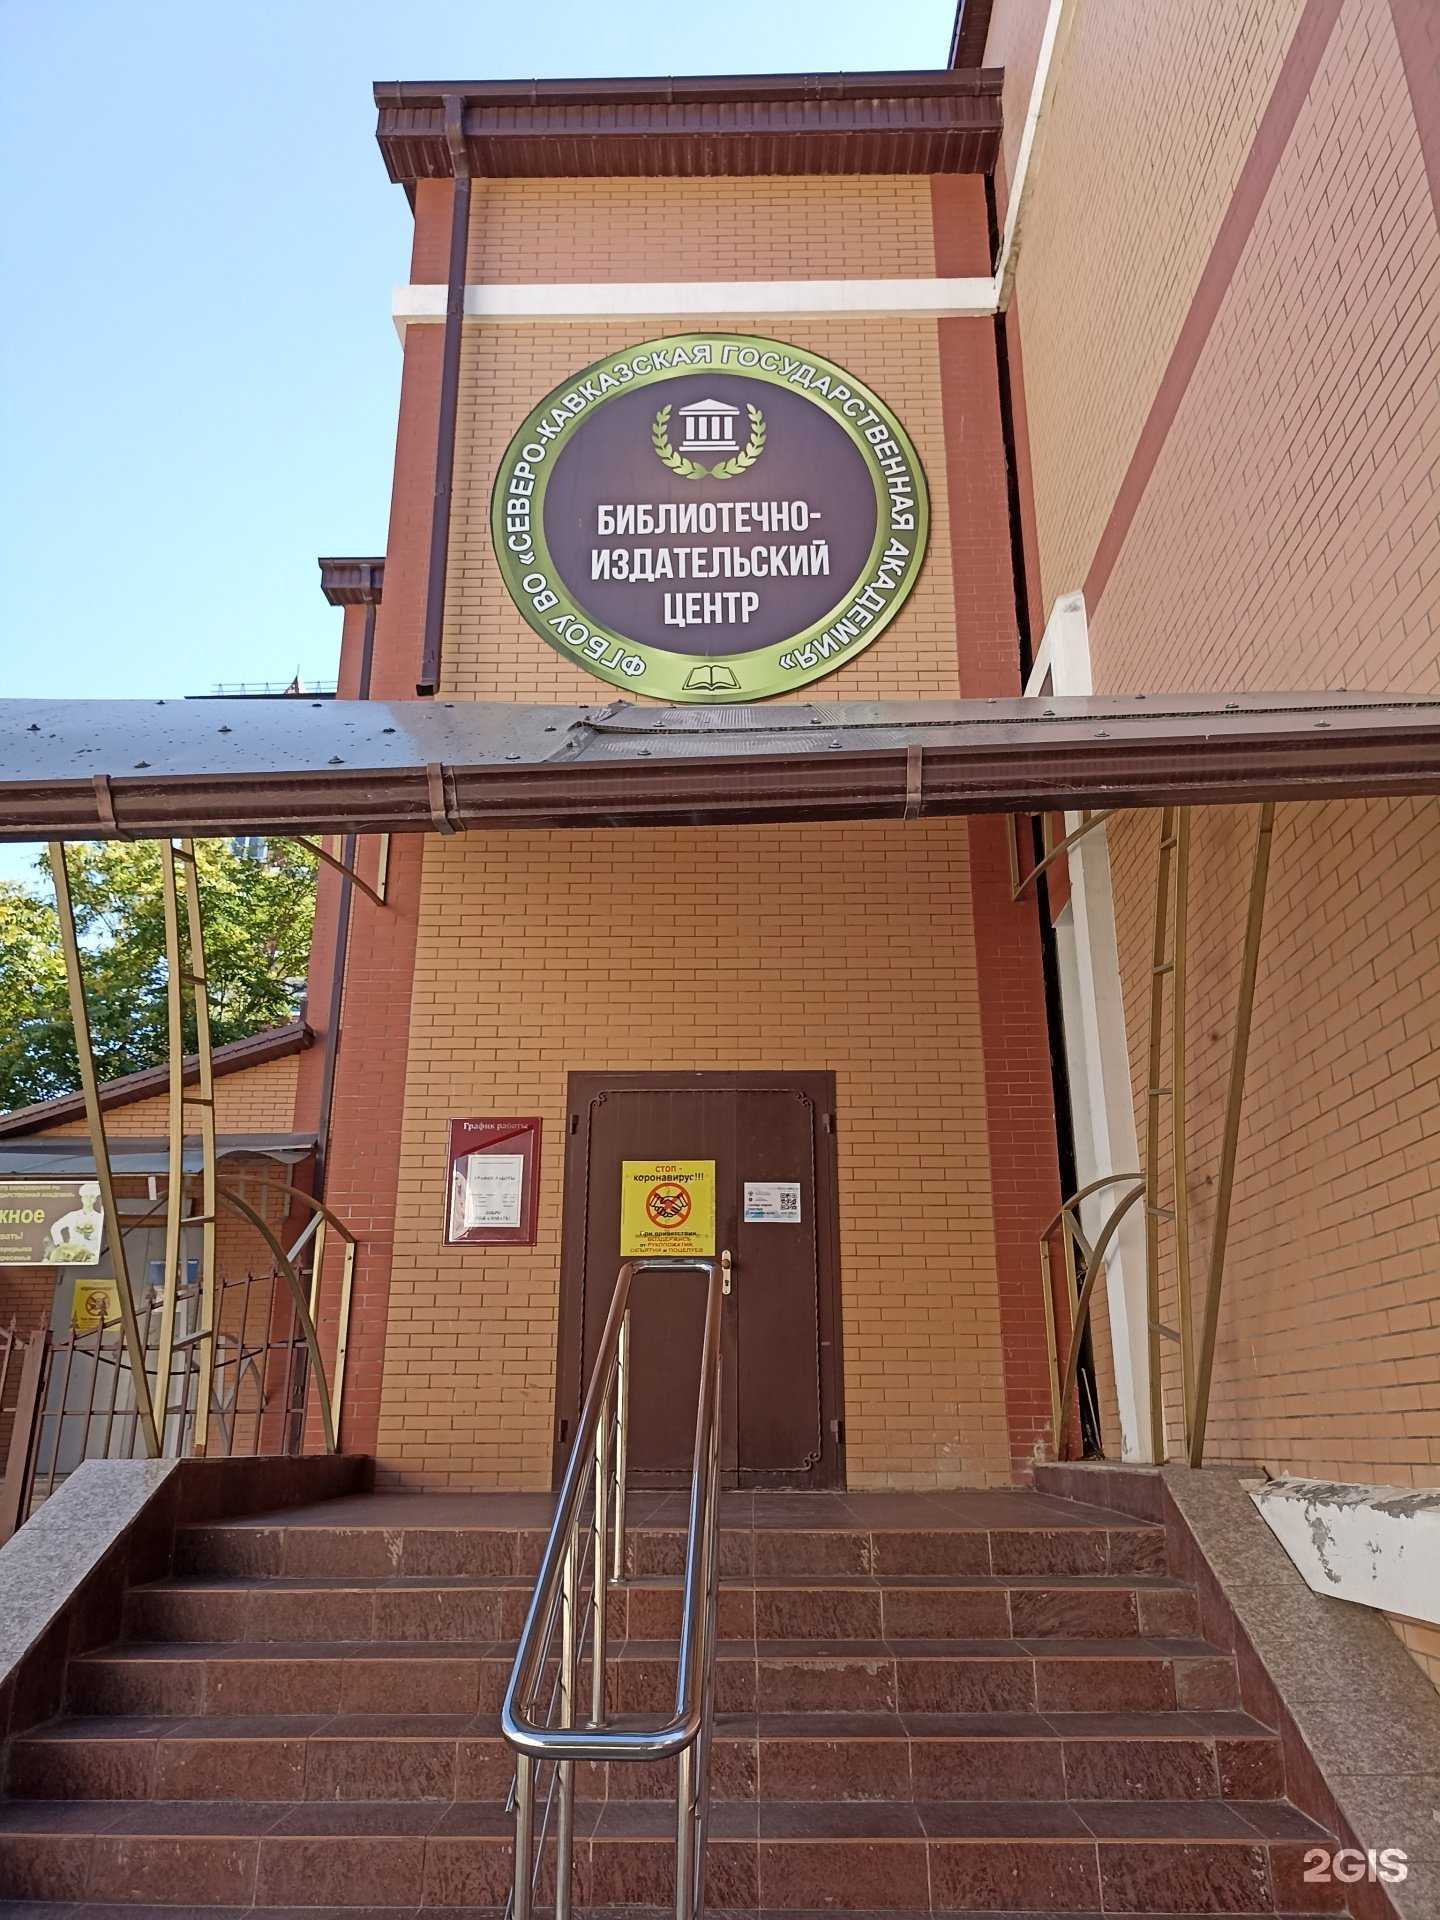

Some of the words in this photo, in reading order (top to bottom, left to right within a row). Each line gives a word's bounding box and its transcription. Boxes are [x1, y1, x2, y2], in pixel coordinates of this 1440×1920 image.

[506, 343, 713, 567] «СЕВЕРО-КАВКАЗСКАЯ
[720, 343, 917, 532] ГОСУДАРСТВЕННАЯ
[596, 500, 822, 536] БИБЛИОТЕЧНО-
[590, 539, 830, 583] ИЗДАТЕЛЬСКИЙ
[521, 572, 562, 614] ВО
[662, 591, 760, 628] ЦЕНТР
[778, 537, 911, 673] АКАДЕМИЯ»
[548, 614, 648, 678] ФГБОУ
[463, 1122, 495, 1131] График
[633, 1173, 704, 1183] коронавирус!!!
